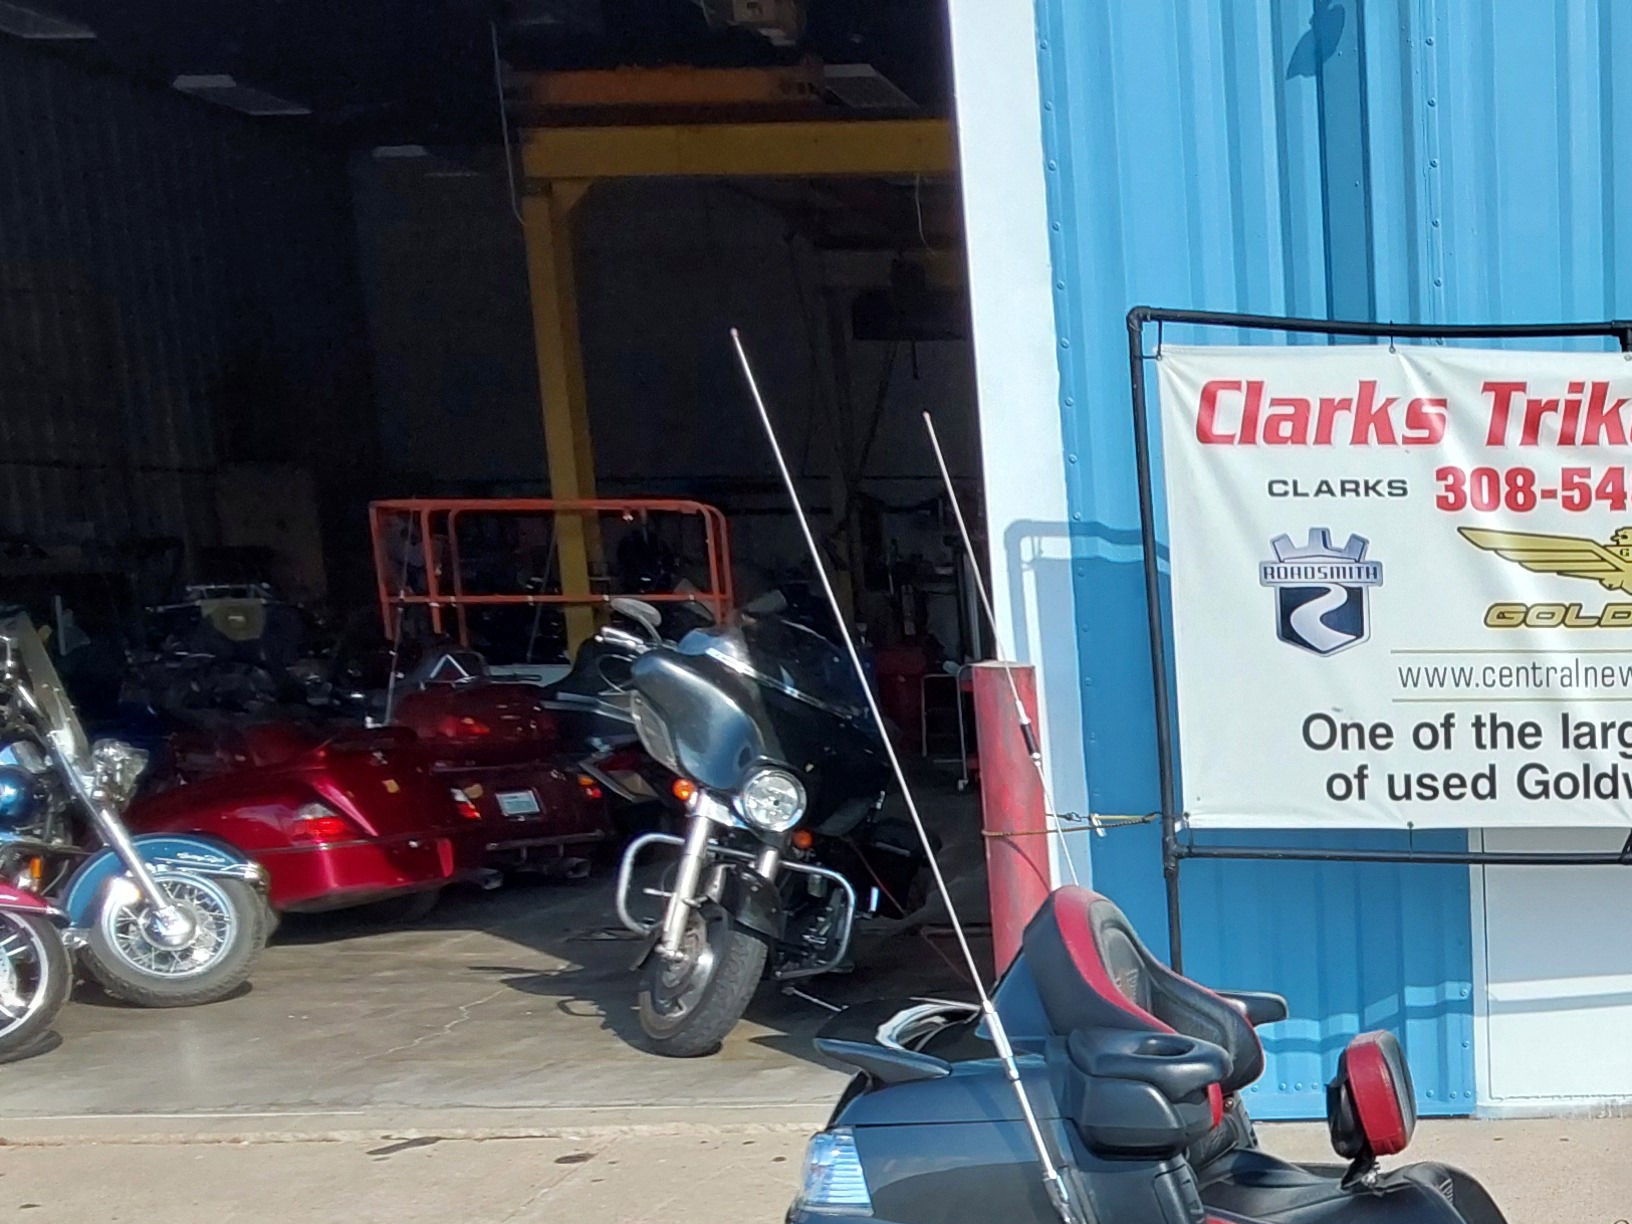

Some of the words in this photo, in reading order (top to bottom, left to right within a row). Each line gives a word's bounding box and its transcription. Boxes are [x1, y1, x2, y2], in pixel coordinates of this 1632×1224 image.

[1195, 379, 1449, 447] Clarks
[1267, 479, 1409, 497] CLARKS
[1263, 566, 1378, 580] ROADSMITH
[1301, 713, 1395, 752] One
[1411, 711, 1456, 751] of
[1471, 711, 1543, 750] the
[1325, 763, 1369, 802] of
[1386, 762, 1498, 802] used
